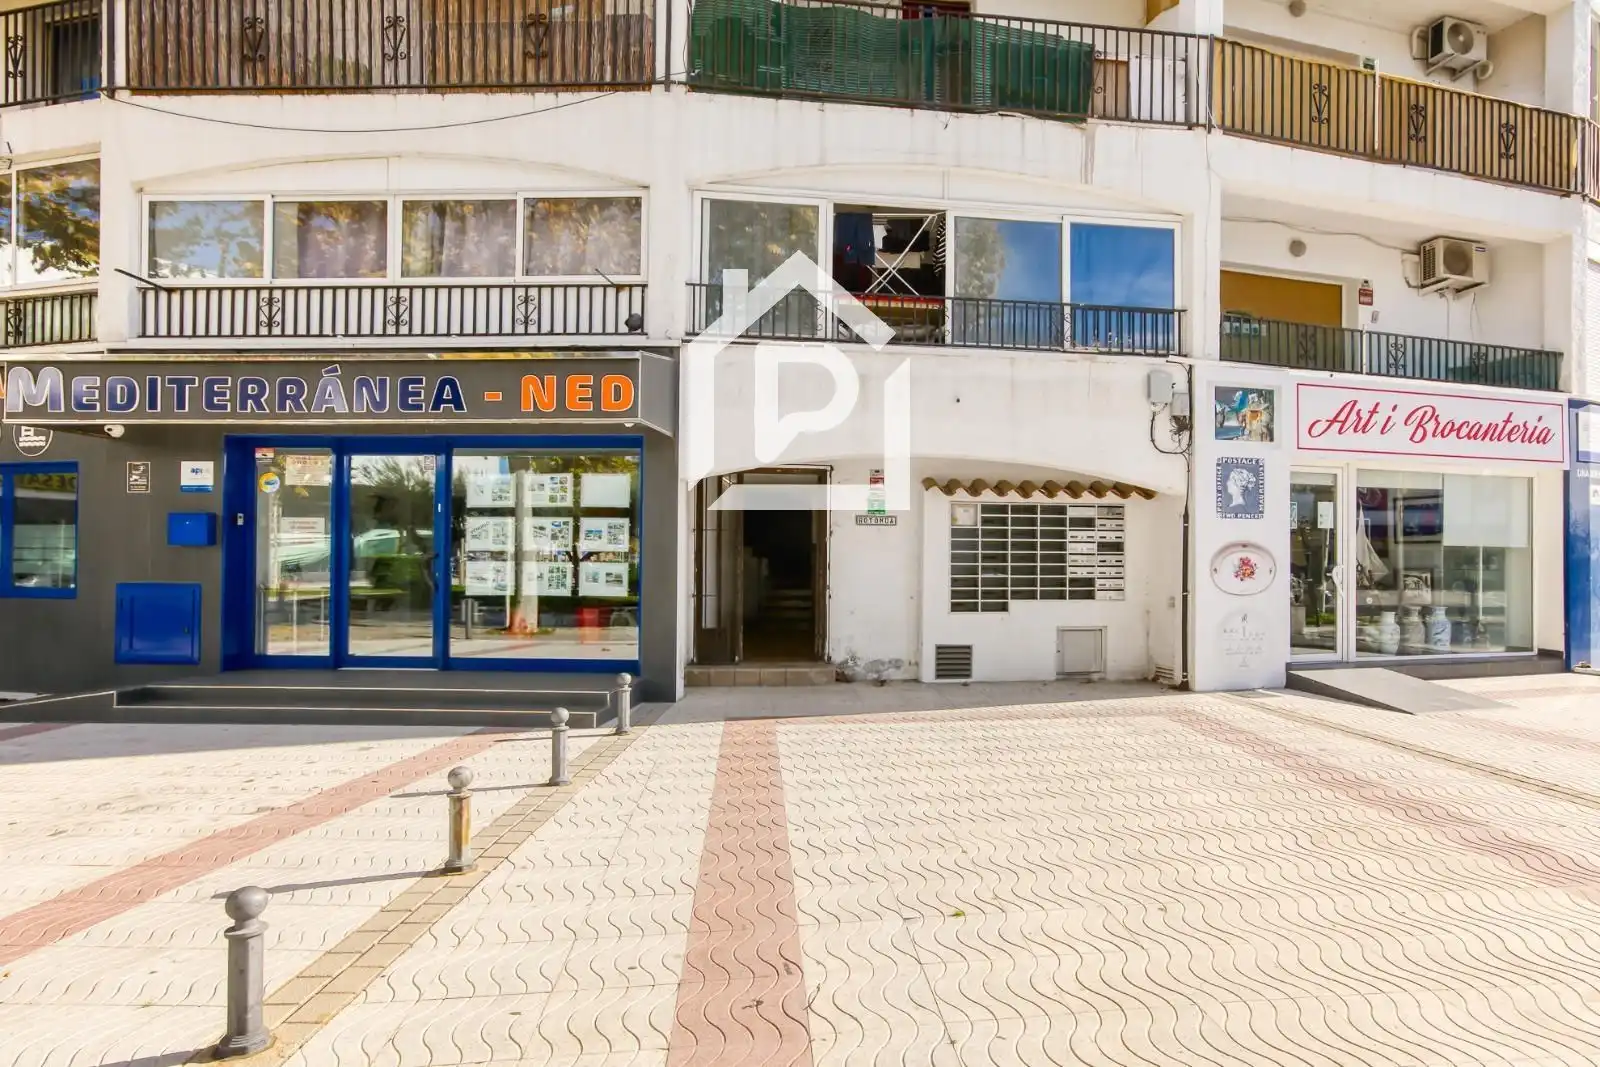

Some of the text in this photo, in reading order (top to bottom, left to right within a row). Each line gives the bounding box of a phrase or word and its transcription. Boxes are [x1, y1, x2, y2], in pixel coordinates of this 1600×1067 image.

[6, 363, 467, 413] MEDITERRÁNEA
[520, 374, 635, 412] NED
[1308, 399, 1555, 445] Art i Brocanteria
